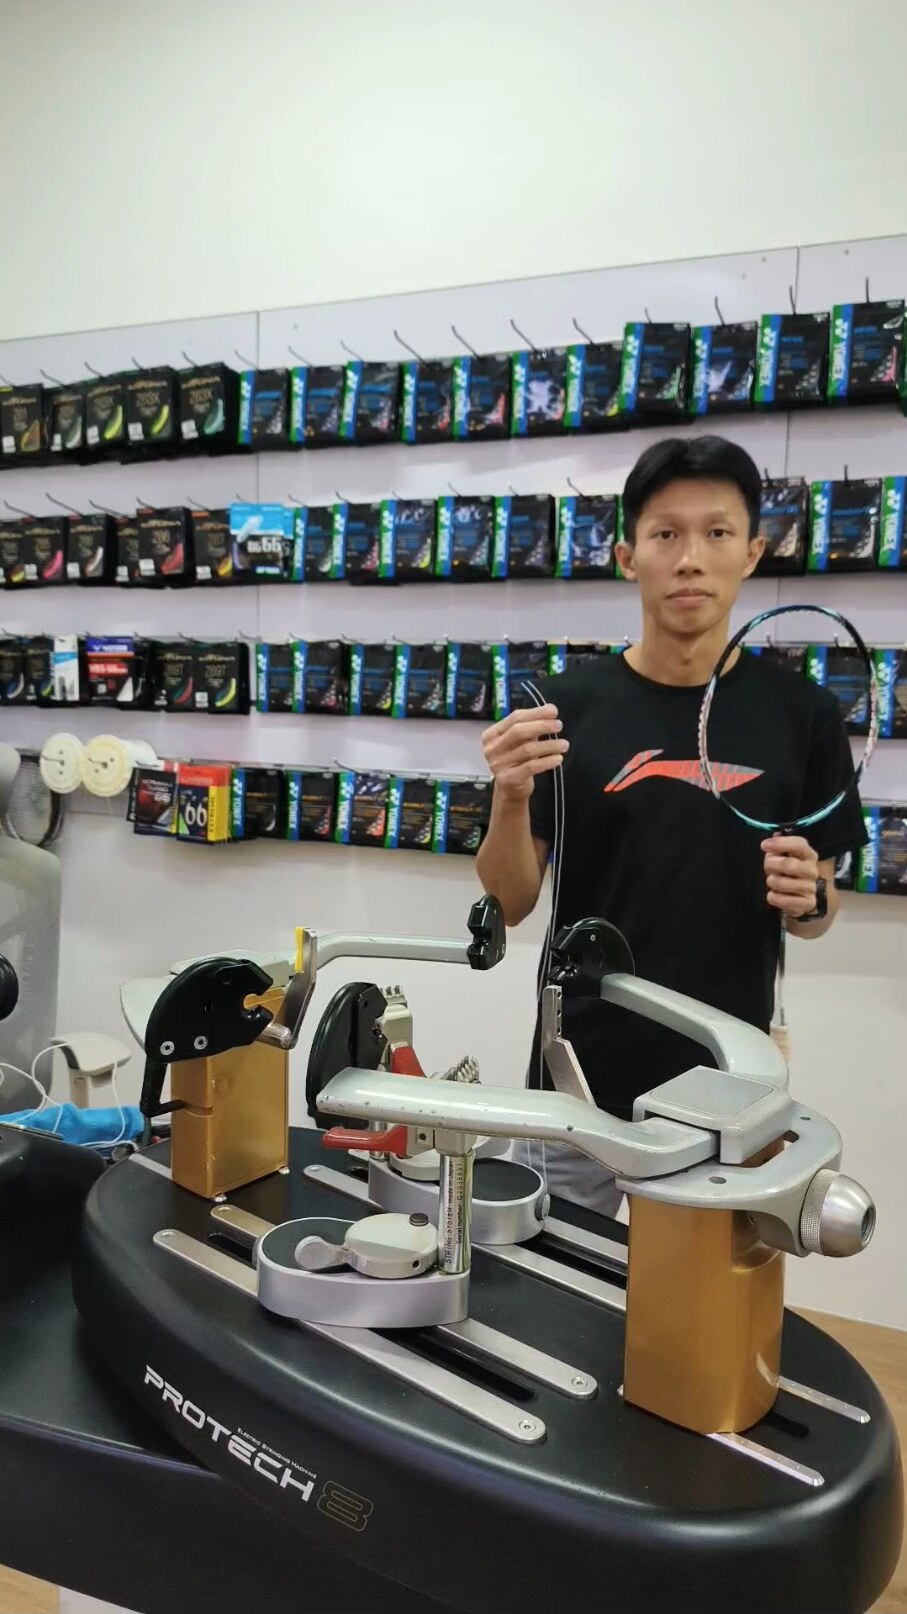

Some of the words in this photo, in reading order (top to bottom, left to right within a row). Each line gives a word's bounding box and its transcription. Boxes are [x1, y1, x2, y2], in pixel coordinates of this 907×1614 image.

[832, 343, 847, 381] YONEX
[494, 677, 506, 708] YONEX
[878, 682, 891, 721] YONEX
[184, 802, 208, 827] 66
[233, 797, 242, 826] YONEX
[289, 801, 298, 829] YONEX
[338, 800, 350, 830] YONEX
[388, 807, 399, 837] YONEX
[435, 811, 446, 842] YONEX
[862, 842, 876, 878] YONEX
[144, 1364, 315, 1502] PROTECH
[316, 1480, 374, 1532] 8
[238, 1427, 261, 1446] ELECTRIC
